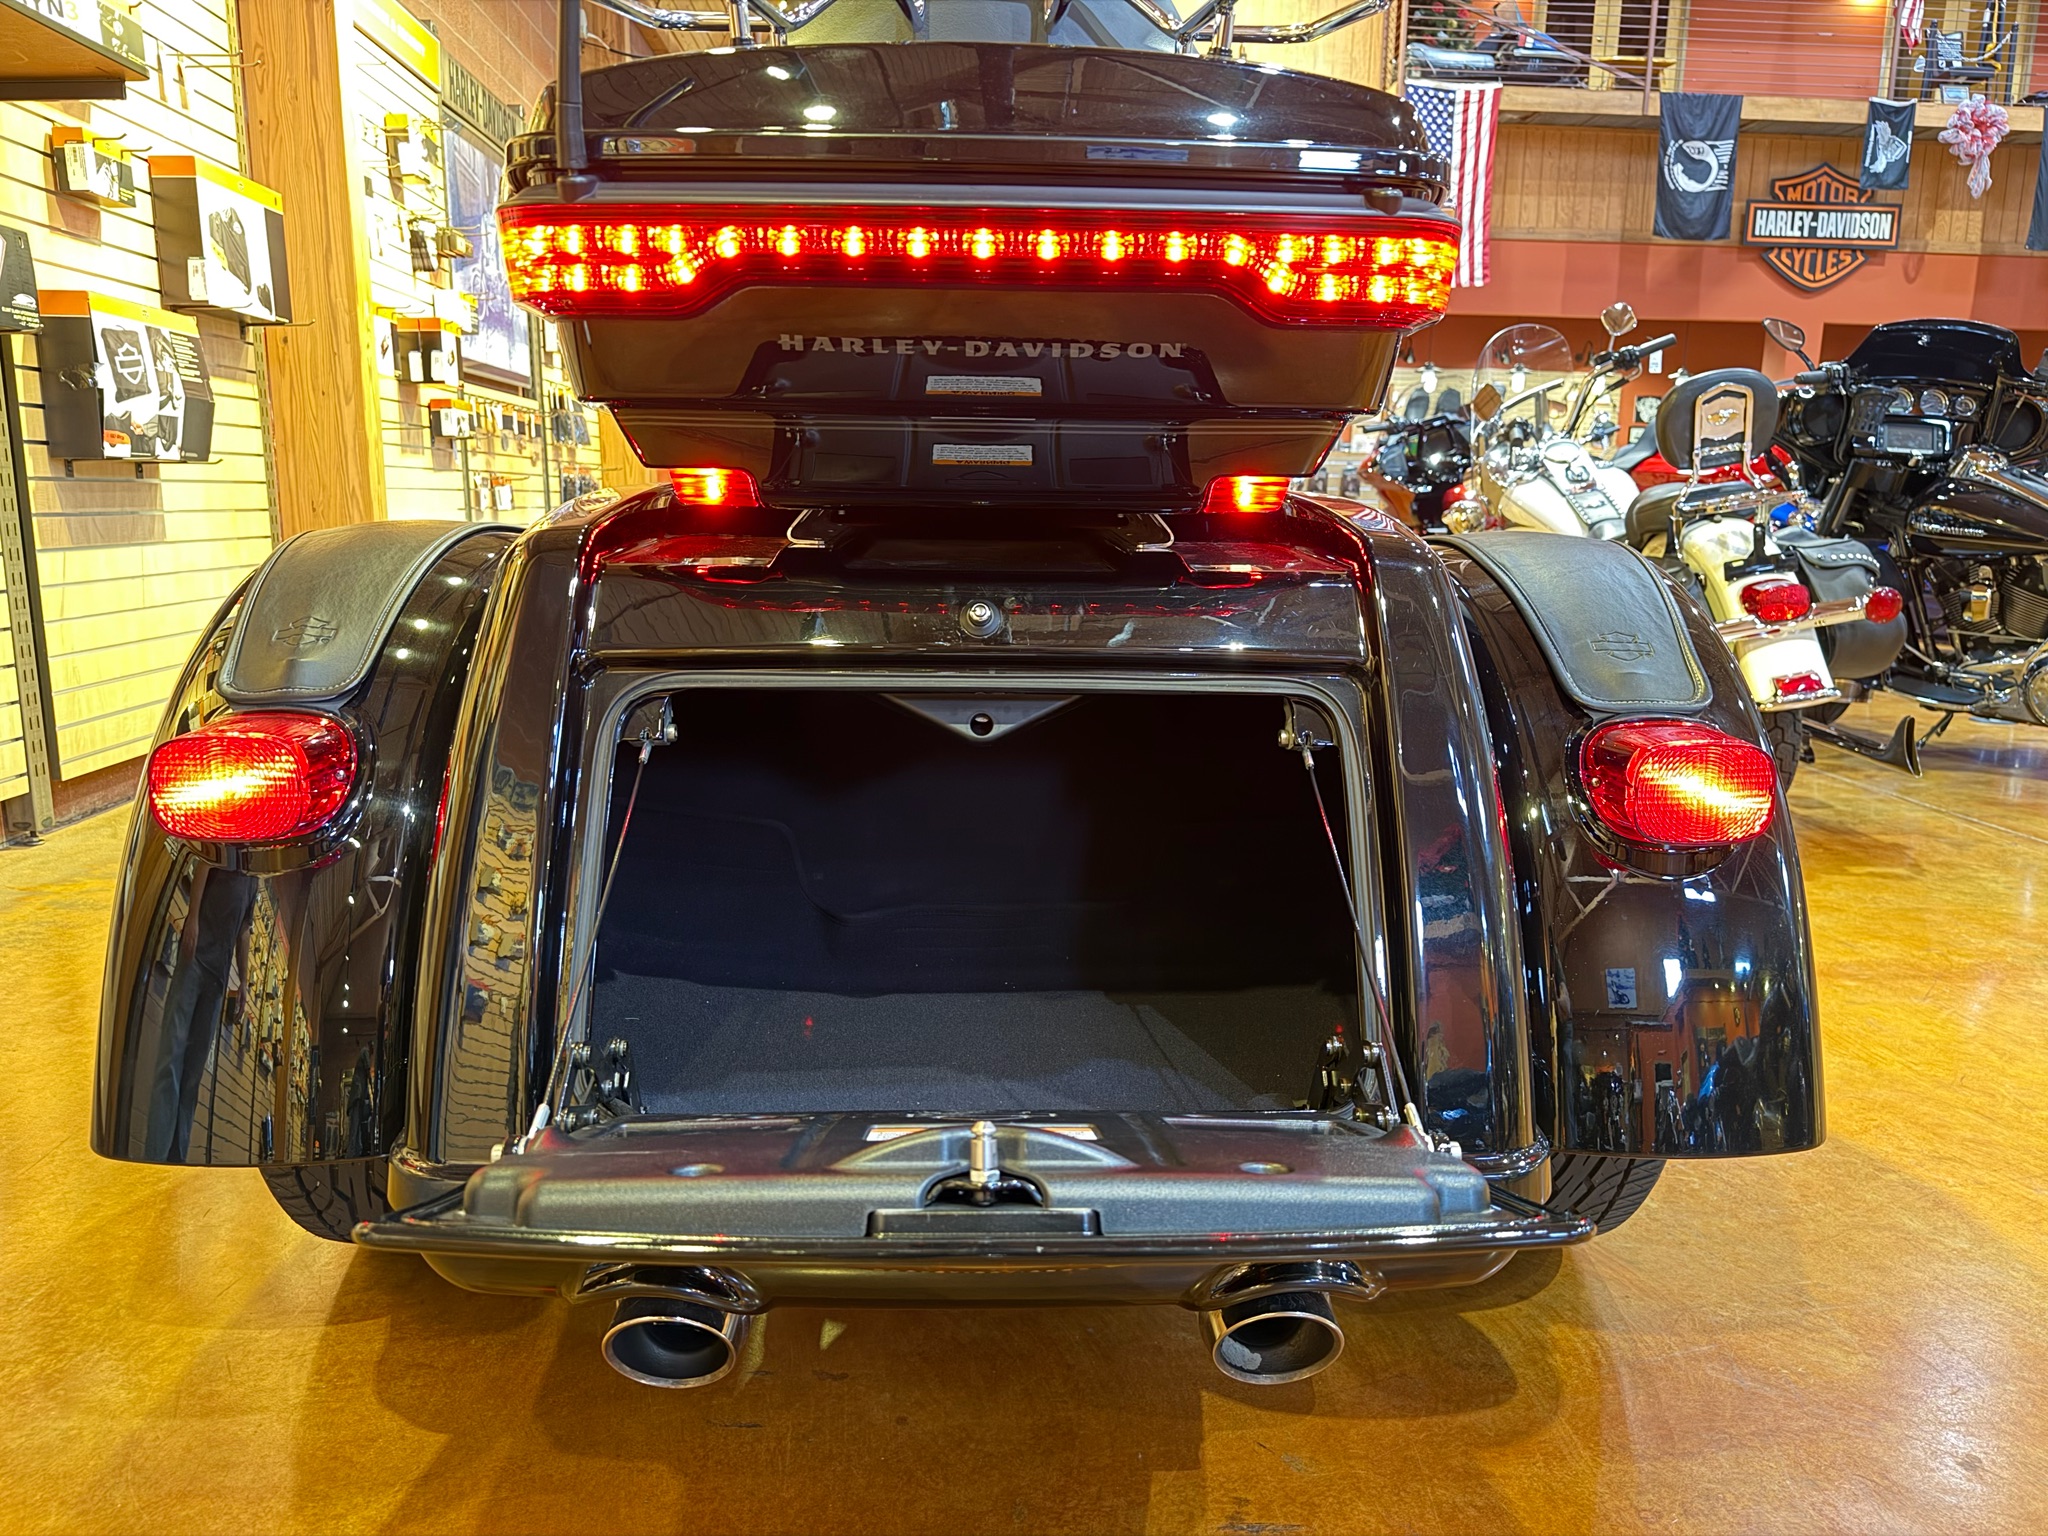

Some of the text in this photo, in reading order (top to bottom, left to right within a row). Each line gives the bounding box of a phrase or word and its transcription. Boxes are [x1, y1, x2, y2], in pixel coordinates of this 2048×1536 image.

[22, 0, 79, 20] YN3
[1787, 174, 1858, 203] MOTOR
[1754, 209, 1892, 240] HARLEY-DAVIDSON
[1780, 248, 1852, 281] CYCLES
[777, 333, 1183, 359] HARLEY-DAVIDSON
